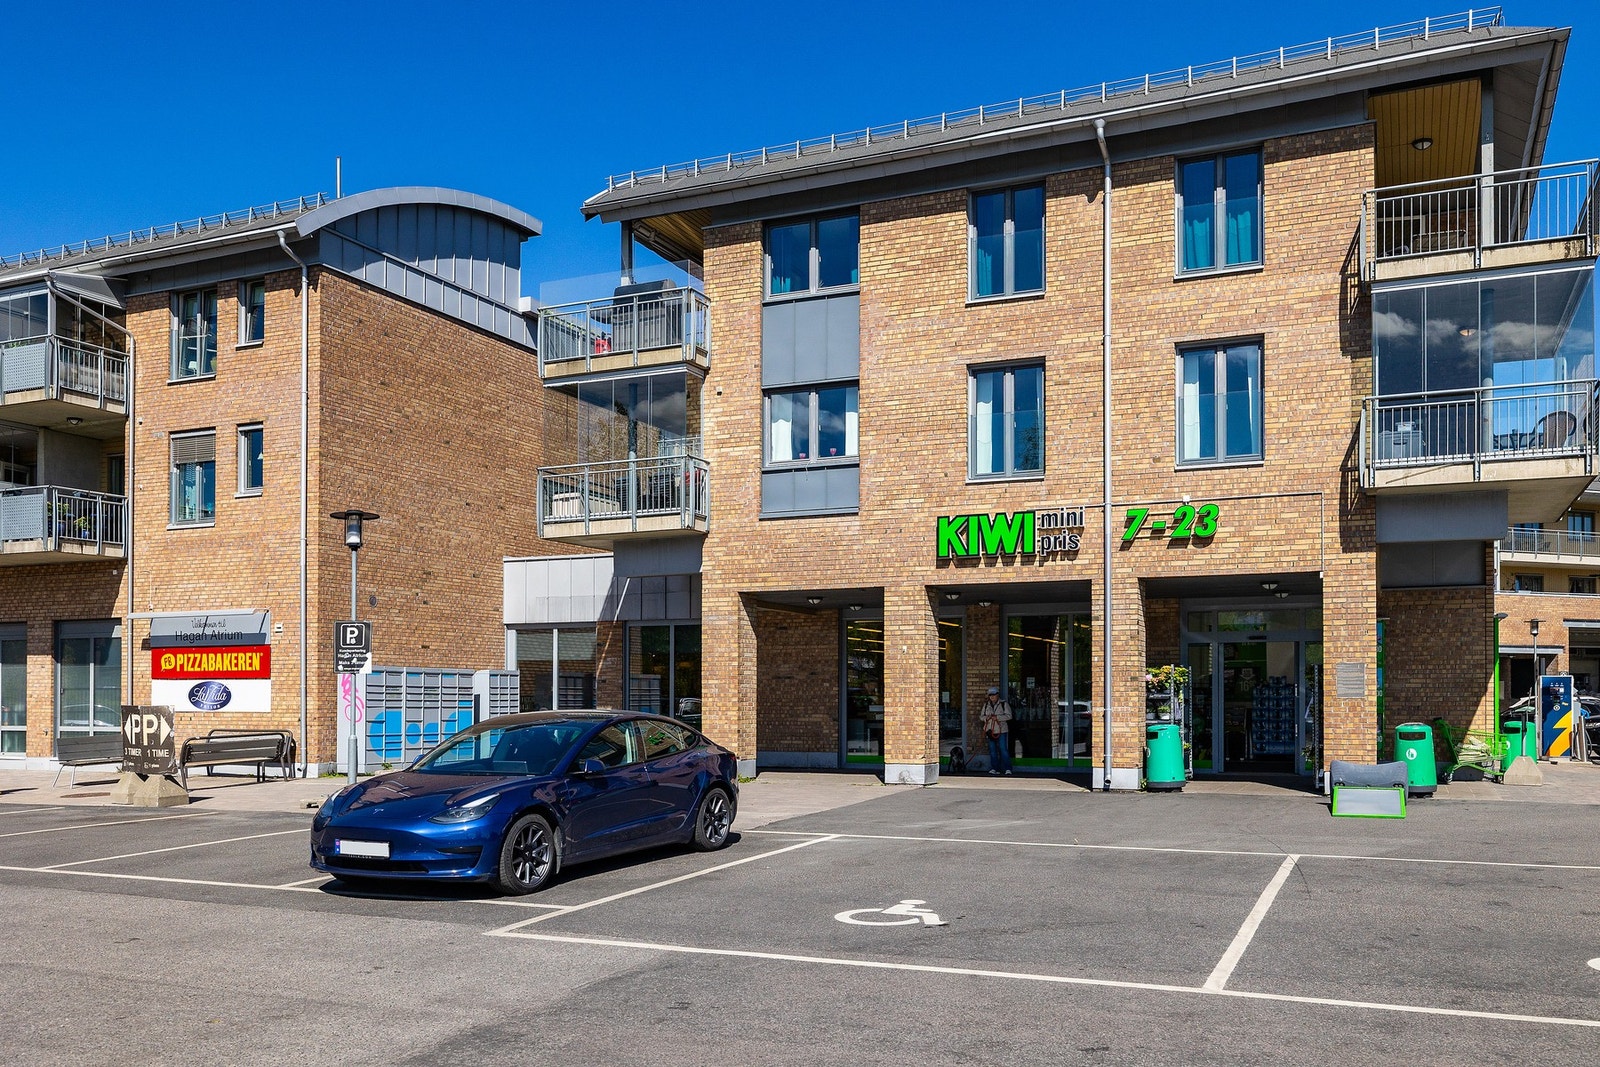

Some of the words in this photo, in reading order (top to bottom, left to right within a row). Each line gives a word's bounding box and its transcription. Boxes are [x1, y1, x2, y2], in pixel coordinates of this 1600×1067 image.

[1040, 506, 1085, 530] mini
[937, 510, 1036, 557] KIWI
[1040, 530, 1080, 556] pris
[175, 630, 207, 643] Hagan
[210, 629, 243, 641] Atrium
[346, 627, 359, 644] P
[176, 652, 261, 672] PIZZABAKEREN
[128, 747, 142, 757] TIMER
[147, 749, 151, 757] 1
[151, 749, 170, 758] TIME
